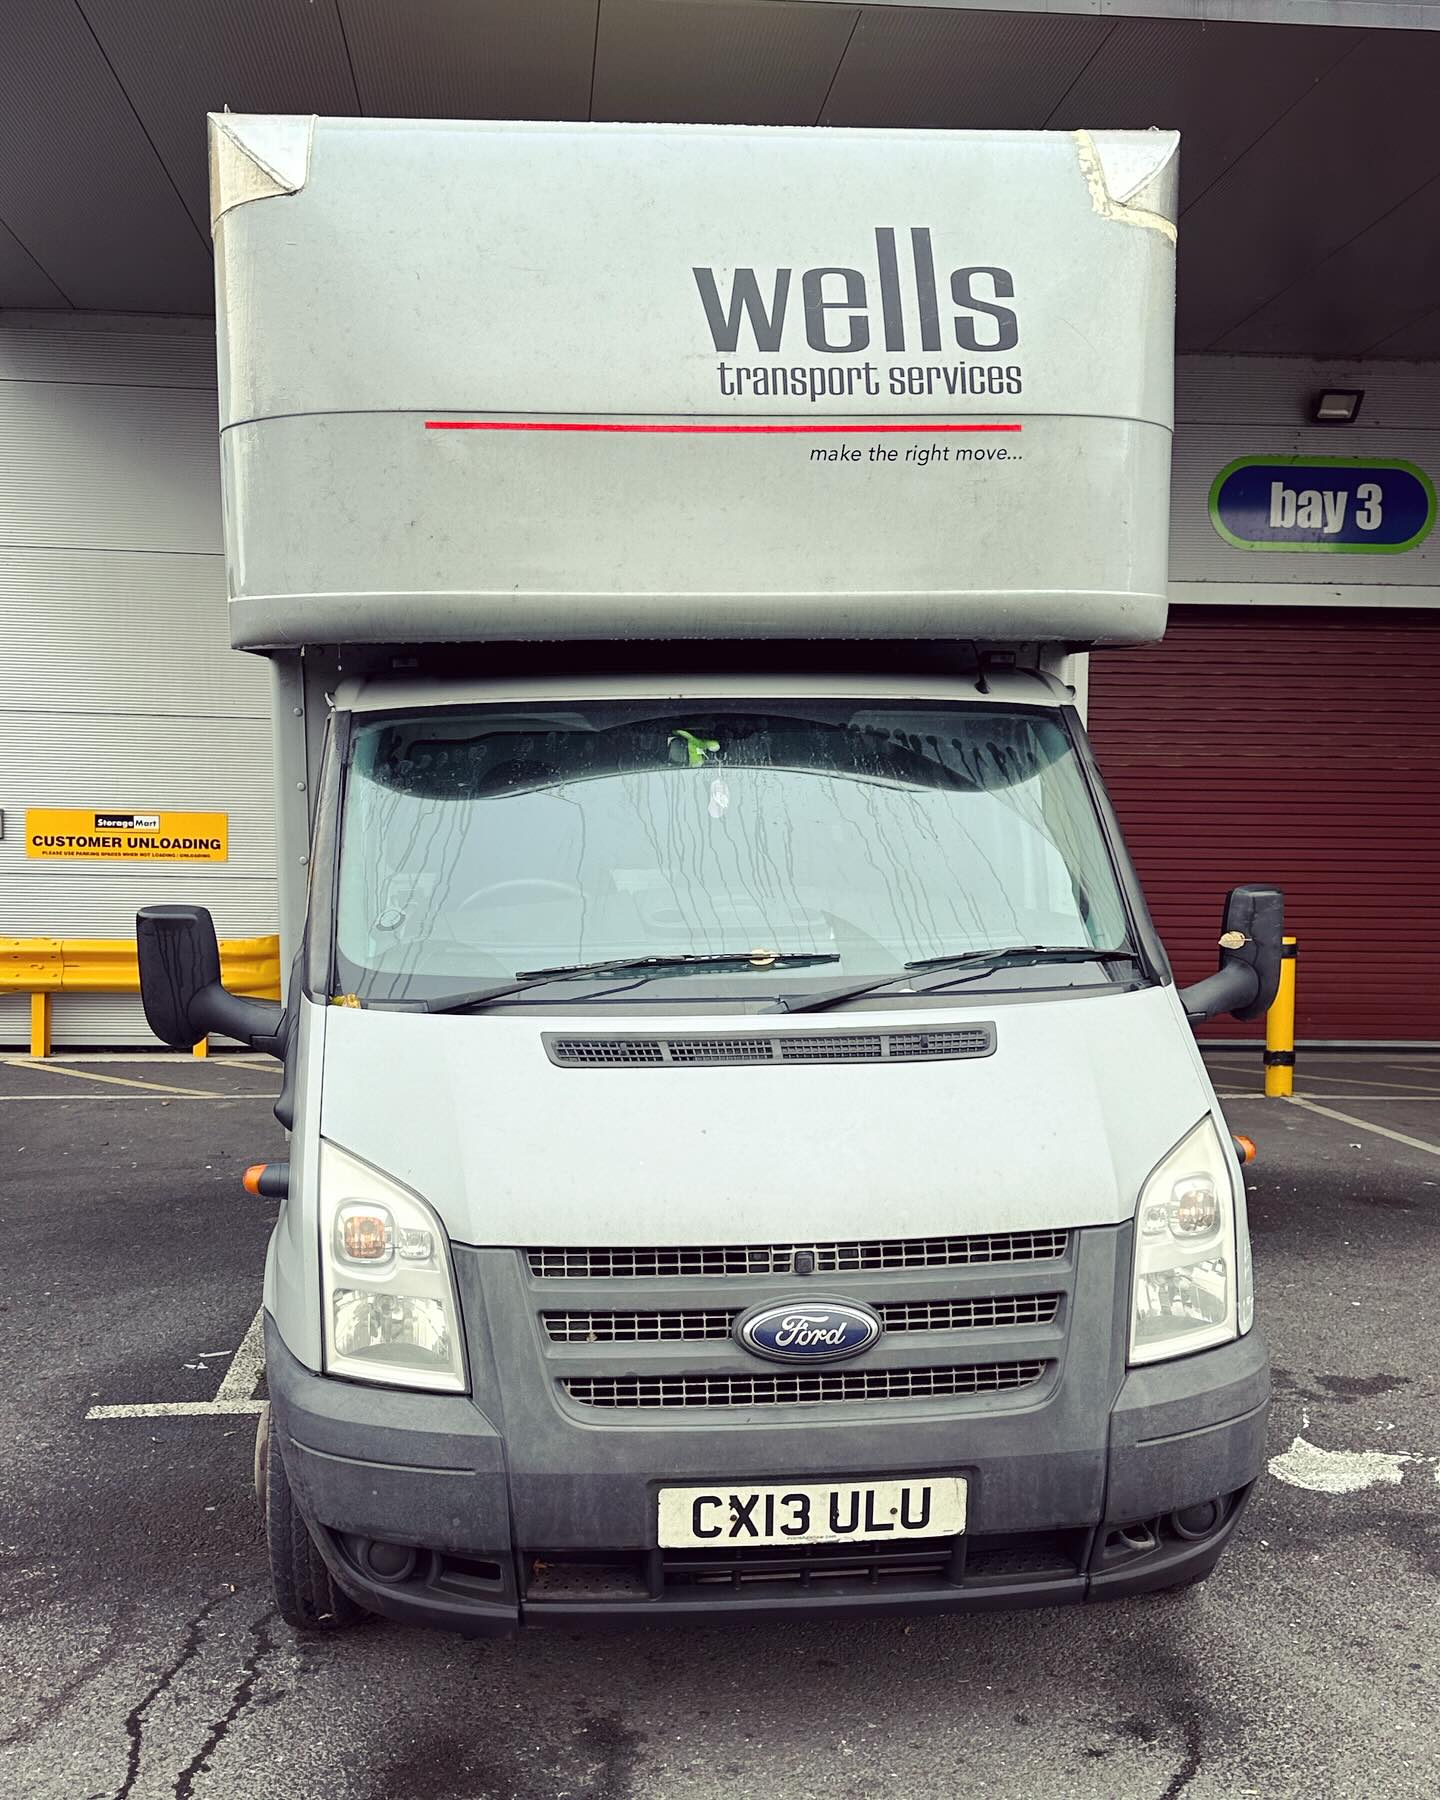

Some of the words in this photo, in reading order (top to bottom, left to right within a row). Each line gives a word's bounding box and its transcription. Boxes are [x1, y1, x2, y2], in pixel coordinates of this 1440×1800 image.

[692, 227, 1019, 353] wells
[717, 362, 879, 402] transport
[889, 361, 1022, 395] services
[810, 444, 861, 461] make
[869, 444, 898, 461] the
[905, 444, 949, 466] right
[955, 448, 1023, 461] move...
[1269, 482, 1348, 533] bay
[1356, 483, 1383, 530] 3
[32, 835, 122, 848] CUSTOMER
[127, 837, 221, 850] UNLOADING
[775, 1315, 847, 1346] Ford
[692, 1494, 811, 1538] CX13
[829, 1487, 932, 1533] ULU
